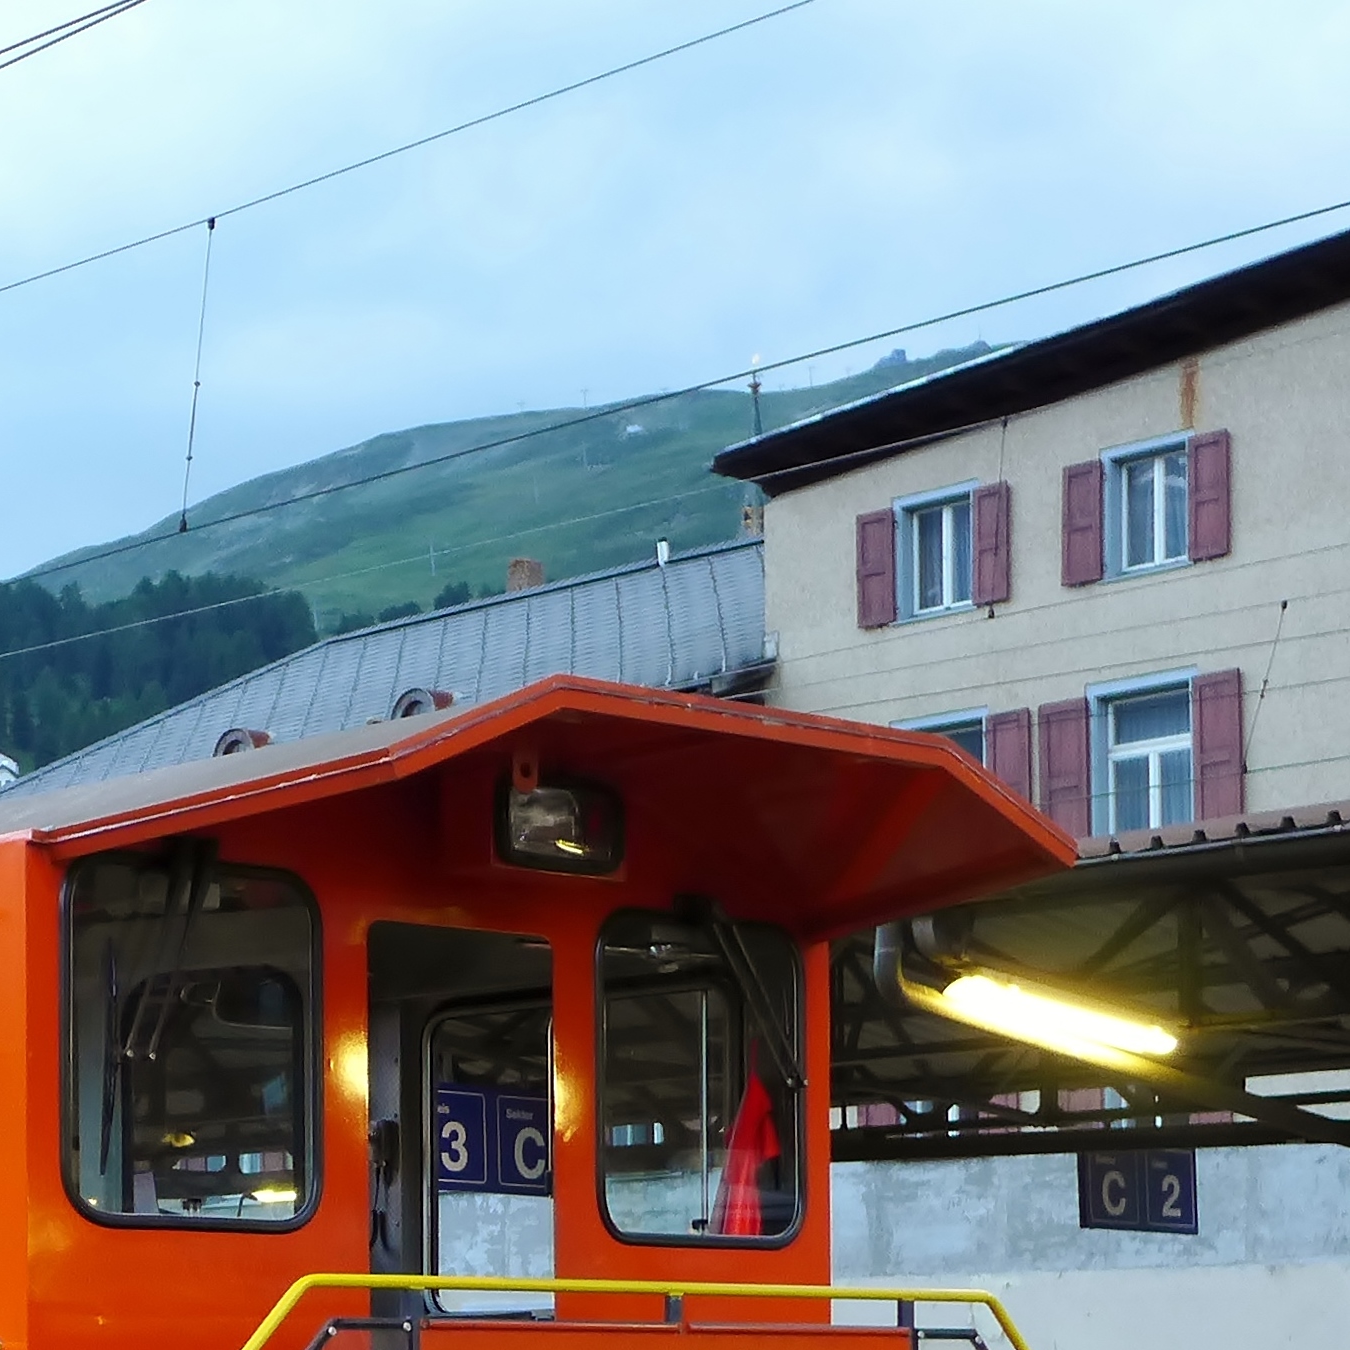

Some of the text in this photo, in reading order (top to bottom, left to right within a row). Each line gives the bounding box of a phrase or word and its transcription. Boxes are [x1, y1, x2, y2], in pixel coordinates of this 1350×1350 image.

[441, 1121, 468, 1172] 3
[514, 1126, 546, 1179] C
[1102, 1171, 1126, 1216] C
[1162, 1174, 1182, 1217] 2
